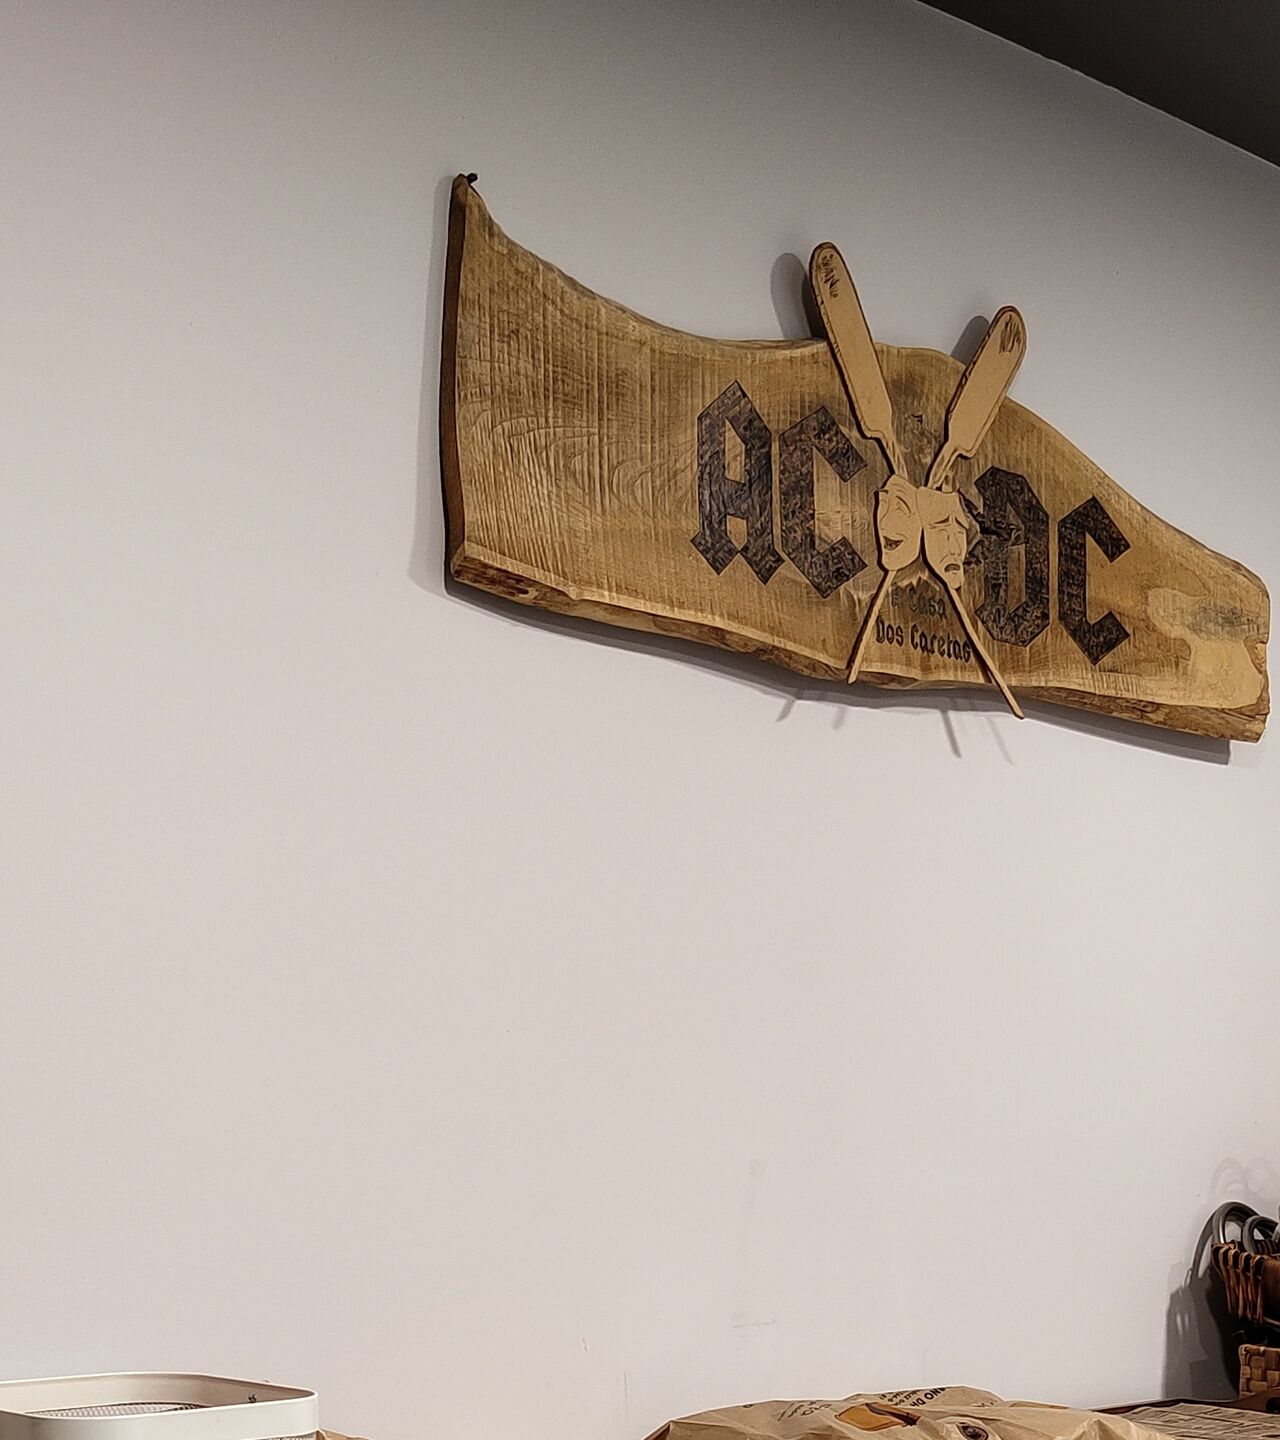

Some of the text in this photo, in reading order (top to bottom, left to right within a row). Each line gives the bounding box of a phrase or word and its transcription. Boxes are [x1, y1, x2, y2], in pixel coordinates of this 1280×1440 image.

[690, 379, 868, 599] AC
[875, 614, 973, 663] Dos Caretas
